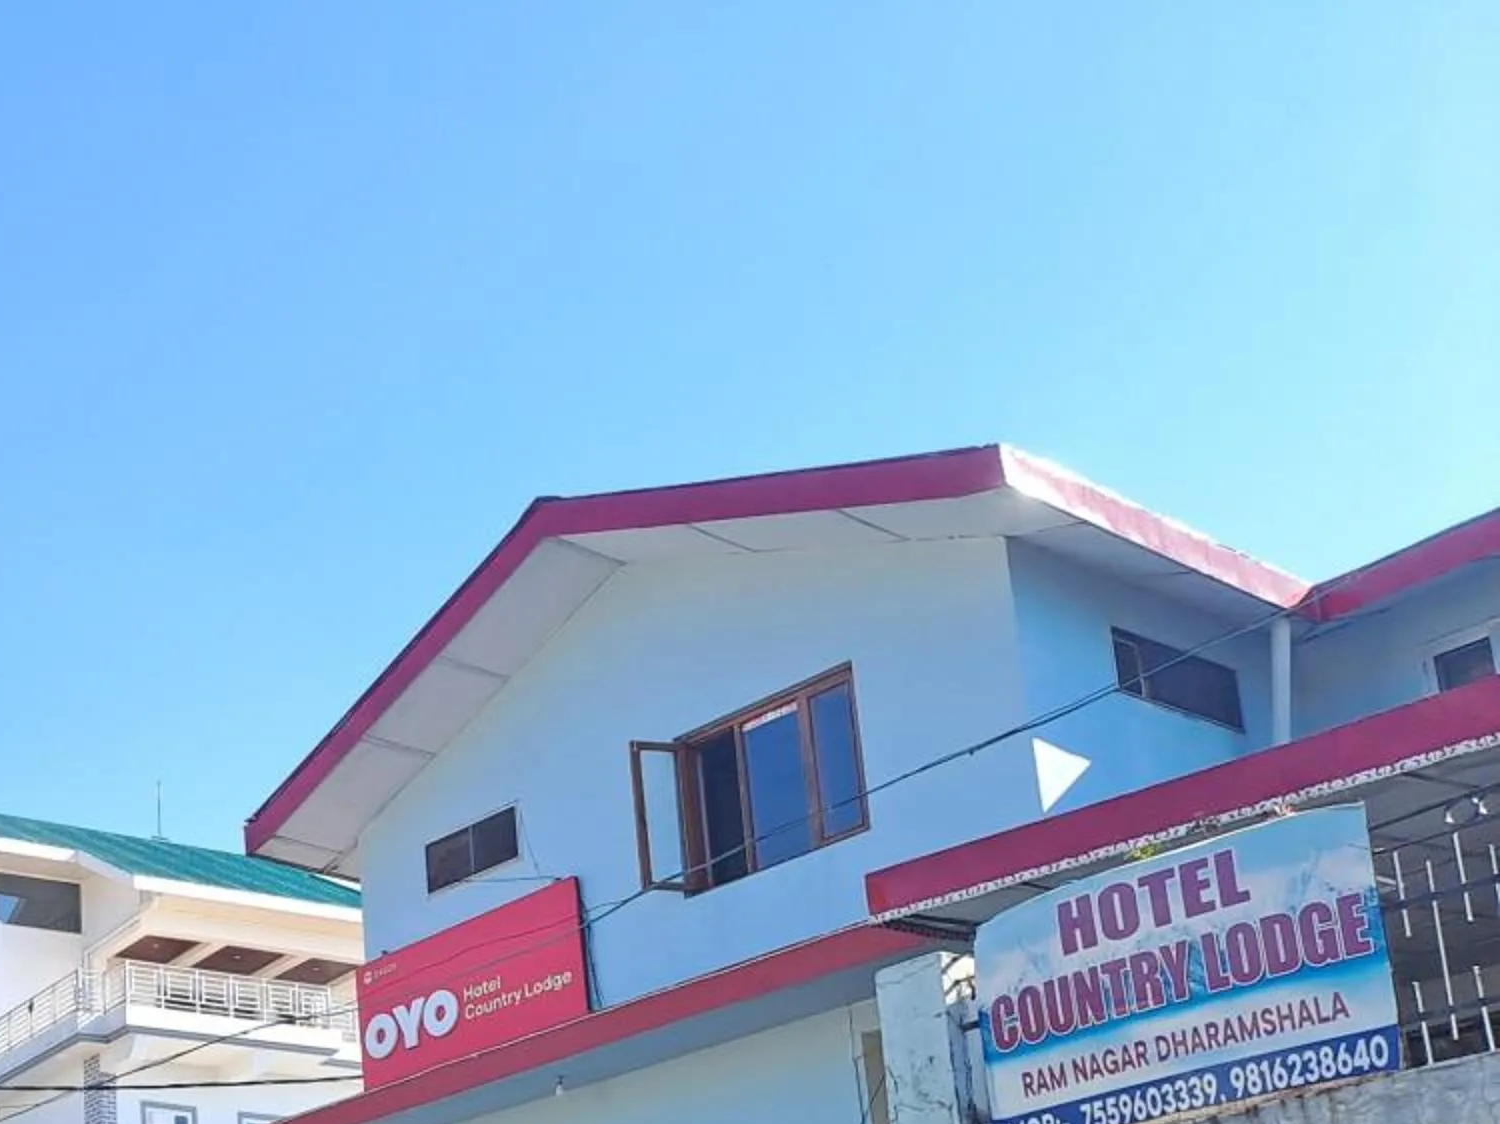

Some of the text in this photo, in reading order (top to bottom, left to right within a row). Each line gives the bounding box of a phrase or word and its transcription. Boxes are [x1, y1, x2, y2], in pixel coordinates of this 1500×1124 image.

[1057, 850, 1250, 957] HOTEL
[463, 976, 502, 1001] Hotel
[464, 971, 573, 1020] Country Lodge
[990, 893, 1373, 1053] COUNTRY LODGE
[365, 990, 459, 1059] OYO
[1021, 991, 1350, 1098] RAM NAGAR DHARAMSHALA
[1229, 1034, 1389, 1099] 9816238640
